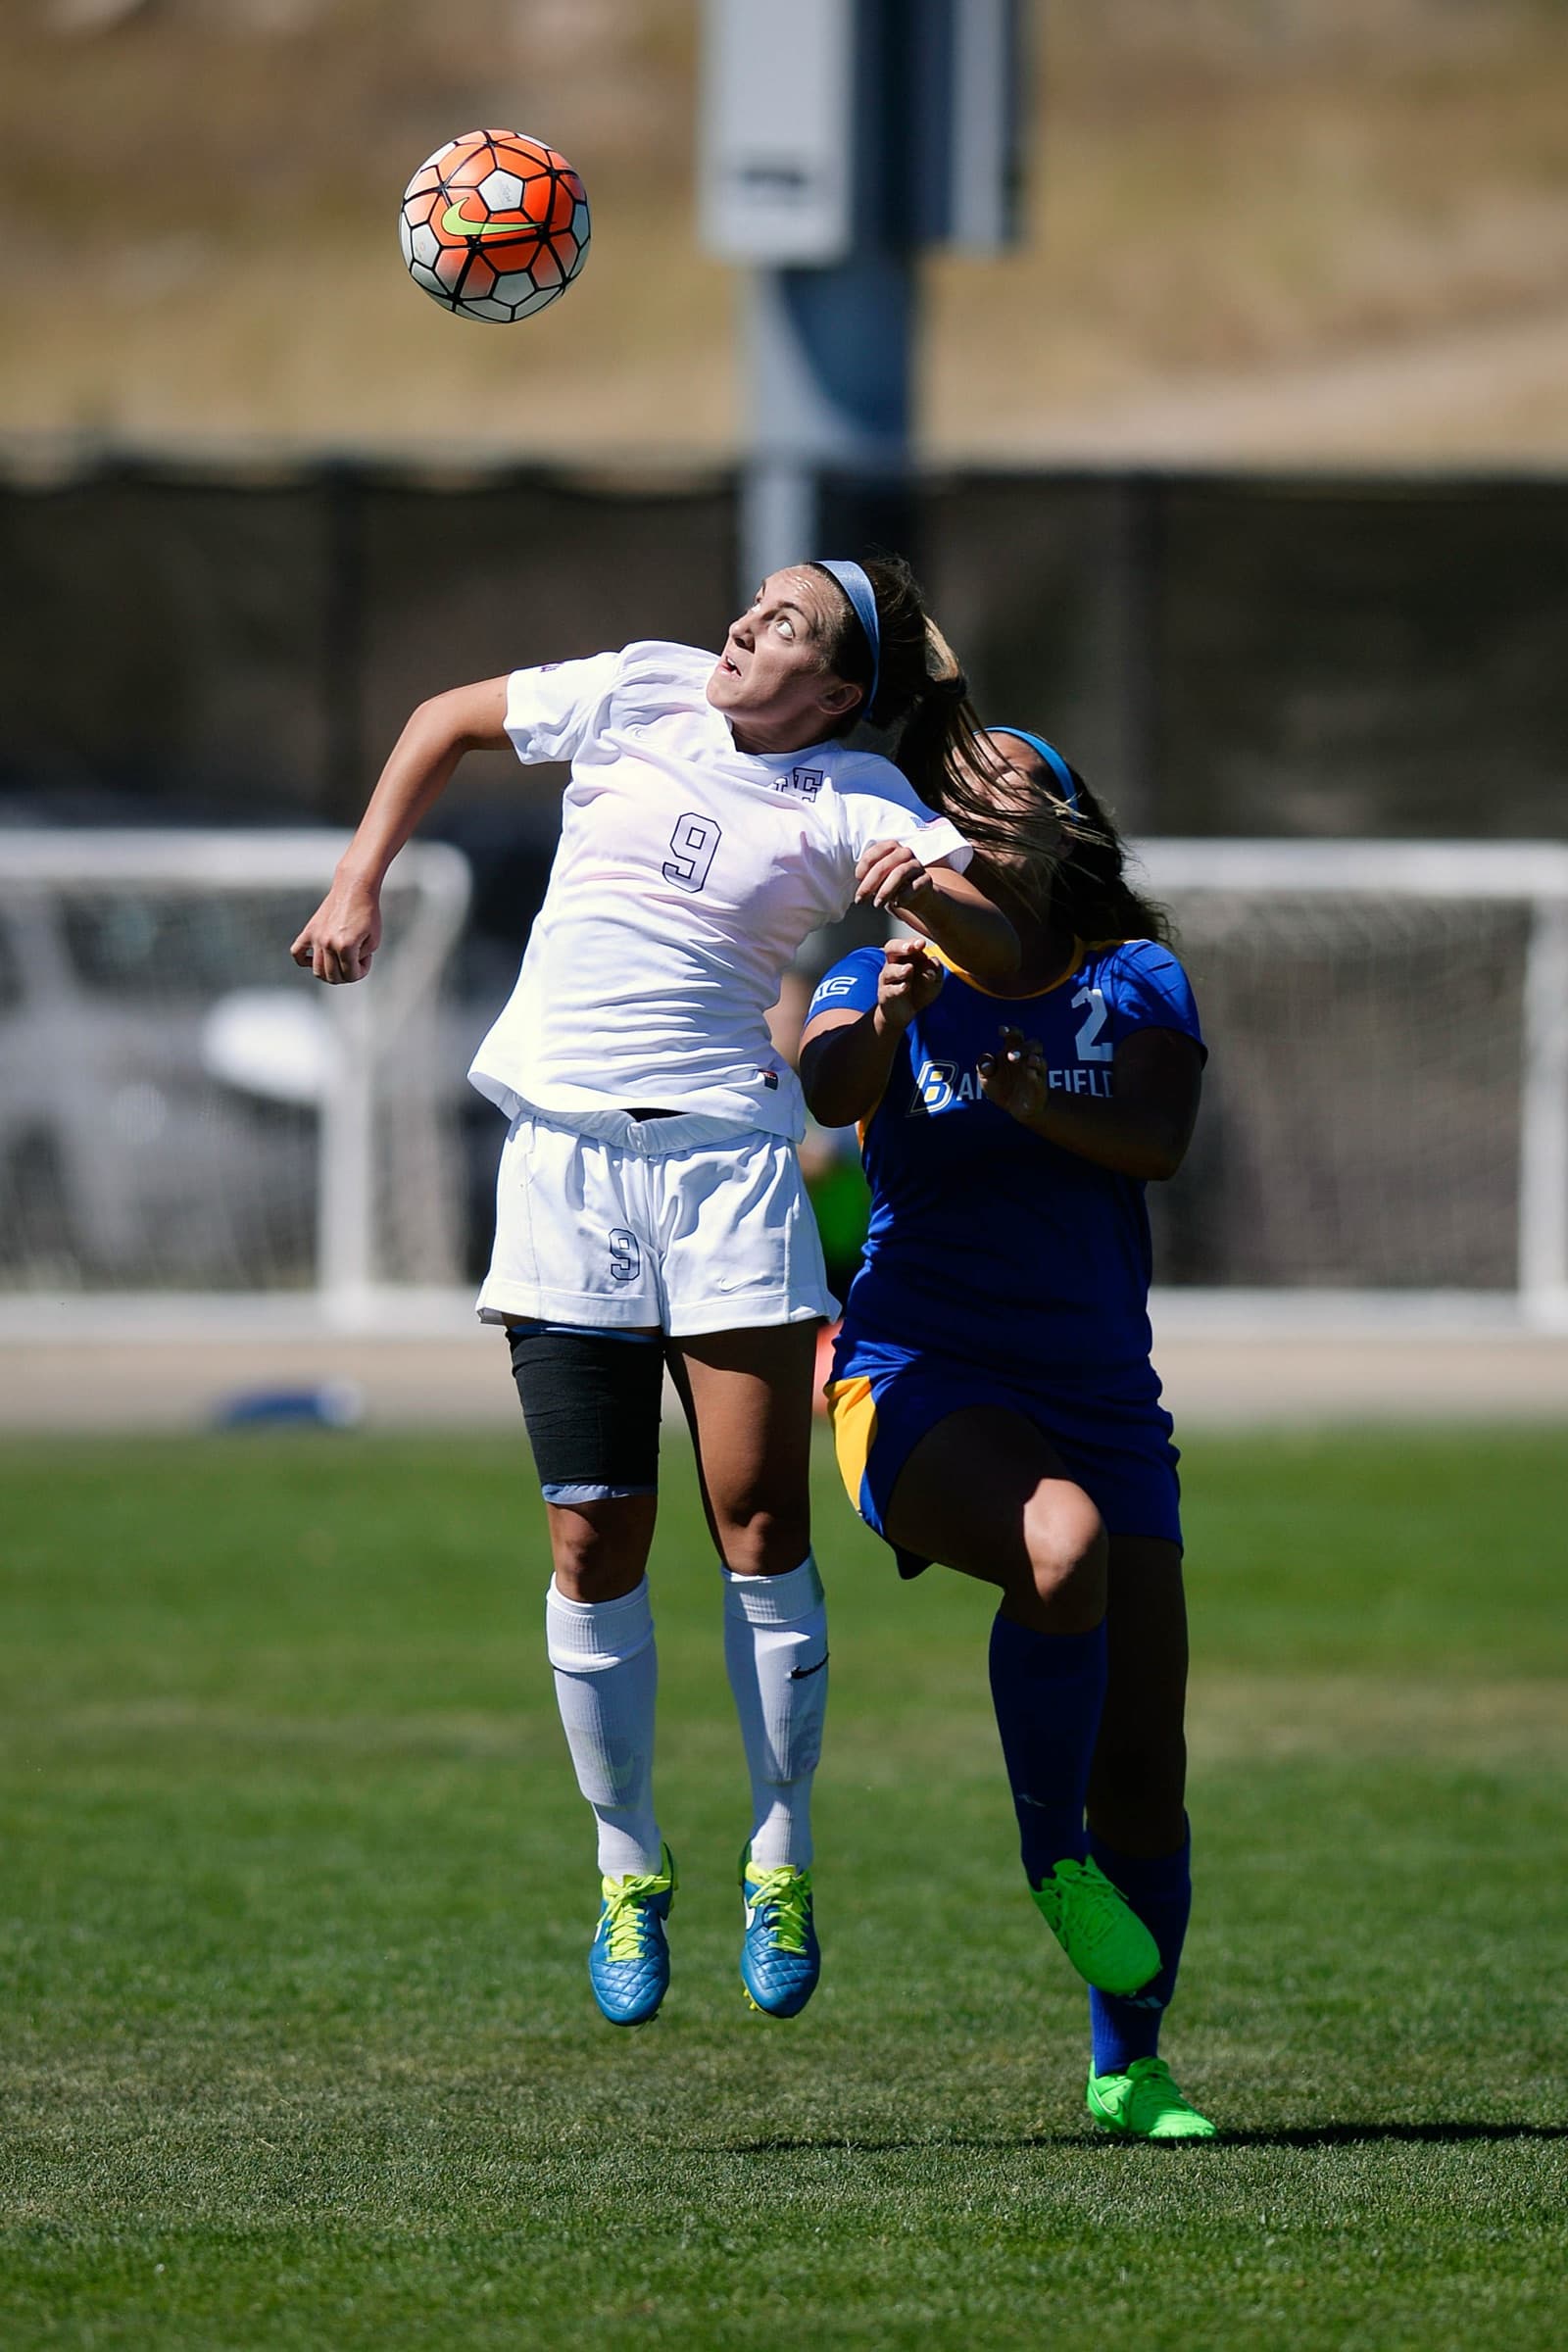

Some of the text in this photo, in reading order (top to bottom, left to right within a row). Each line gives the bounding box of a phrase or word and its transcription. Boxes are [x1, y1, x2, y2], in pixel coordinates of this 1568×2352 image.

[662, 812, 721, 893] 9
[1071, 986, 1114, 1061] 2
[609, 1228, 640, 1280] 9
